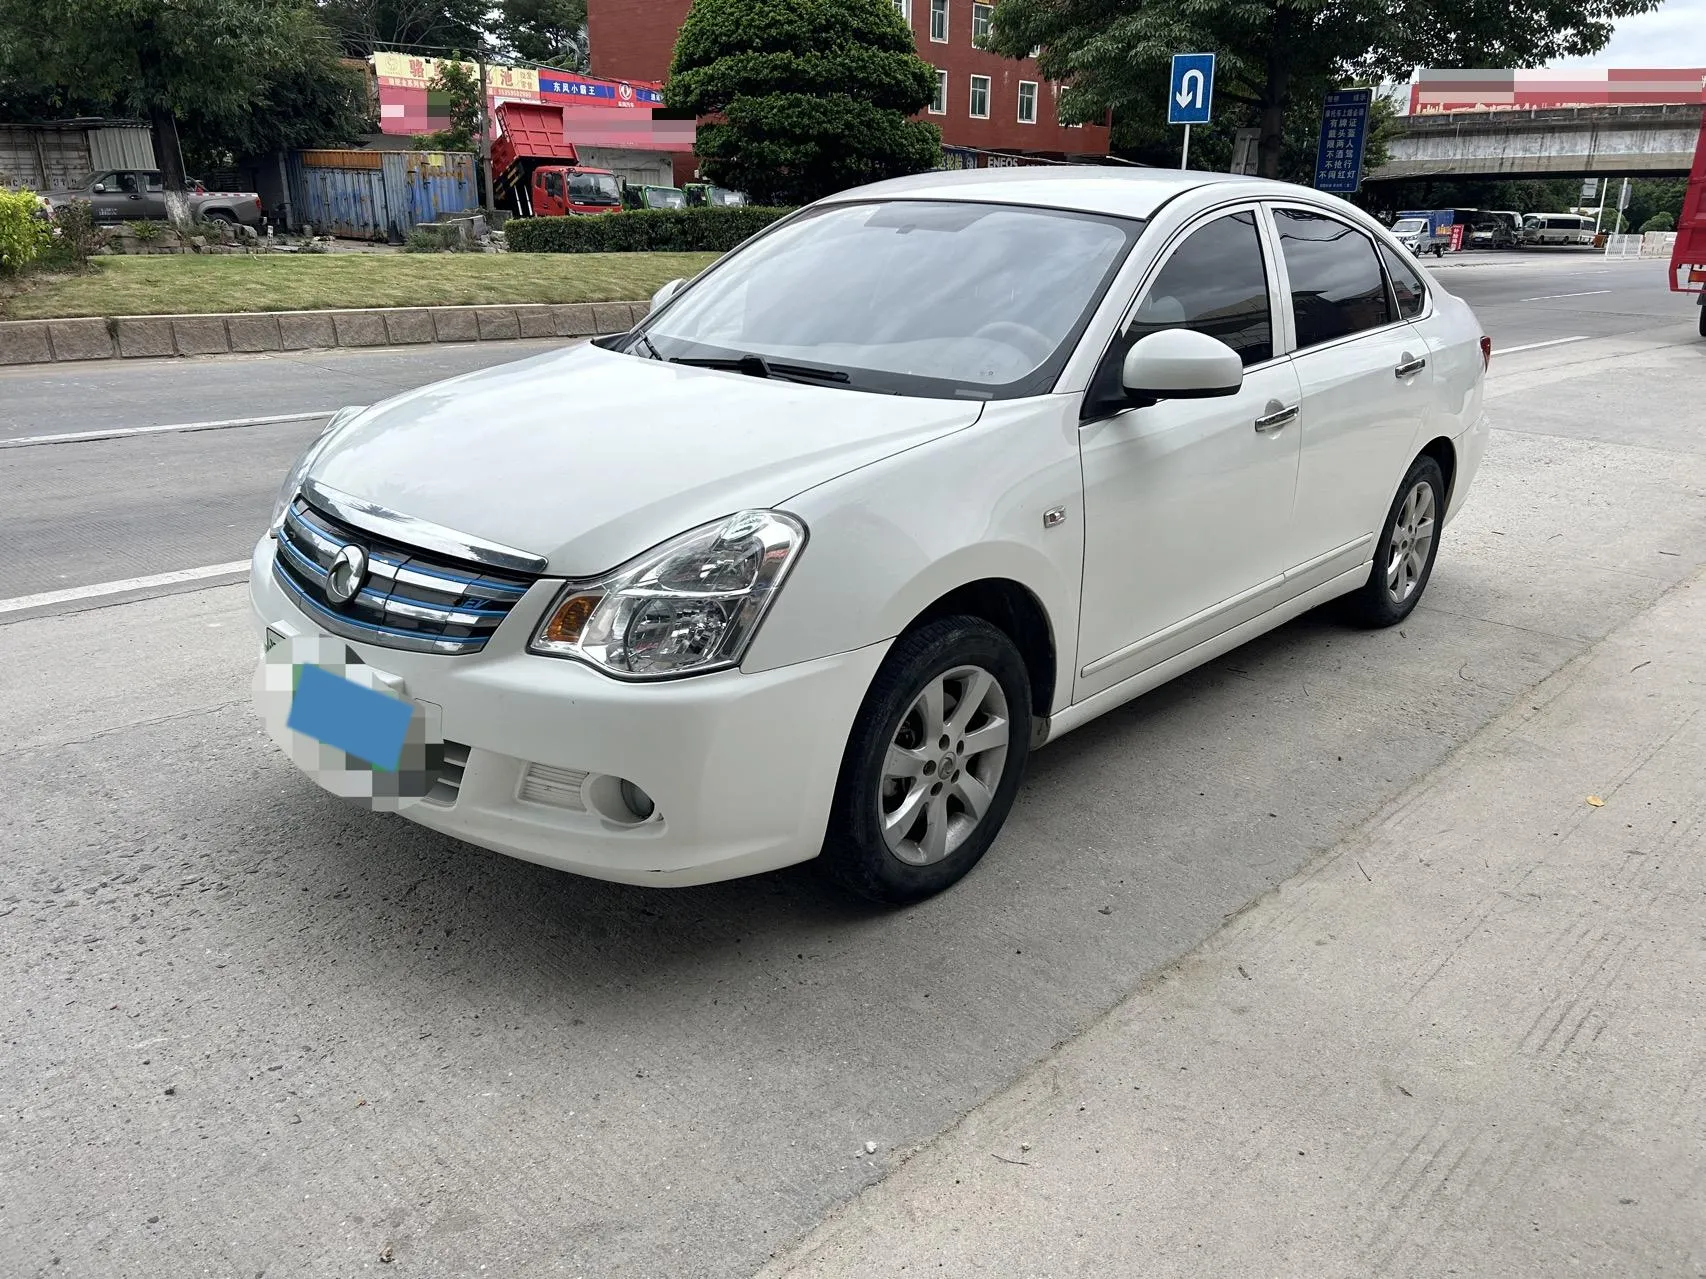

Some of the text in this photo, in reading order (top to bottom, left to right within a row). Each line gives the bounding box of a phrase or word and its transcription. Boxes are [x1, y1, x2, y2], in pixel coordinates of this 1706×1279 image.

[553, 82, 596, 96] 东风小霸王
[1330, 118, 1357, 128] 有牌证
[1328, 129, 1356, 138] 戴头盔
[1326, 139, 1354, 149] 限两人
[1326, 149, 1354, 159] 不酒驾
[987, 156, 1018, 168] ENEOS
[1319, 170, 1356, 179] 不闯红灯
